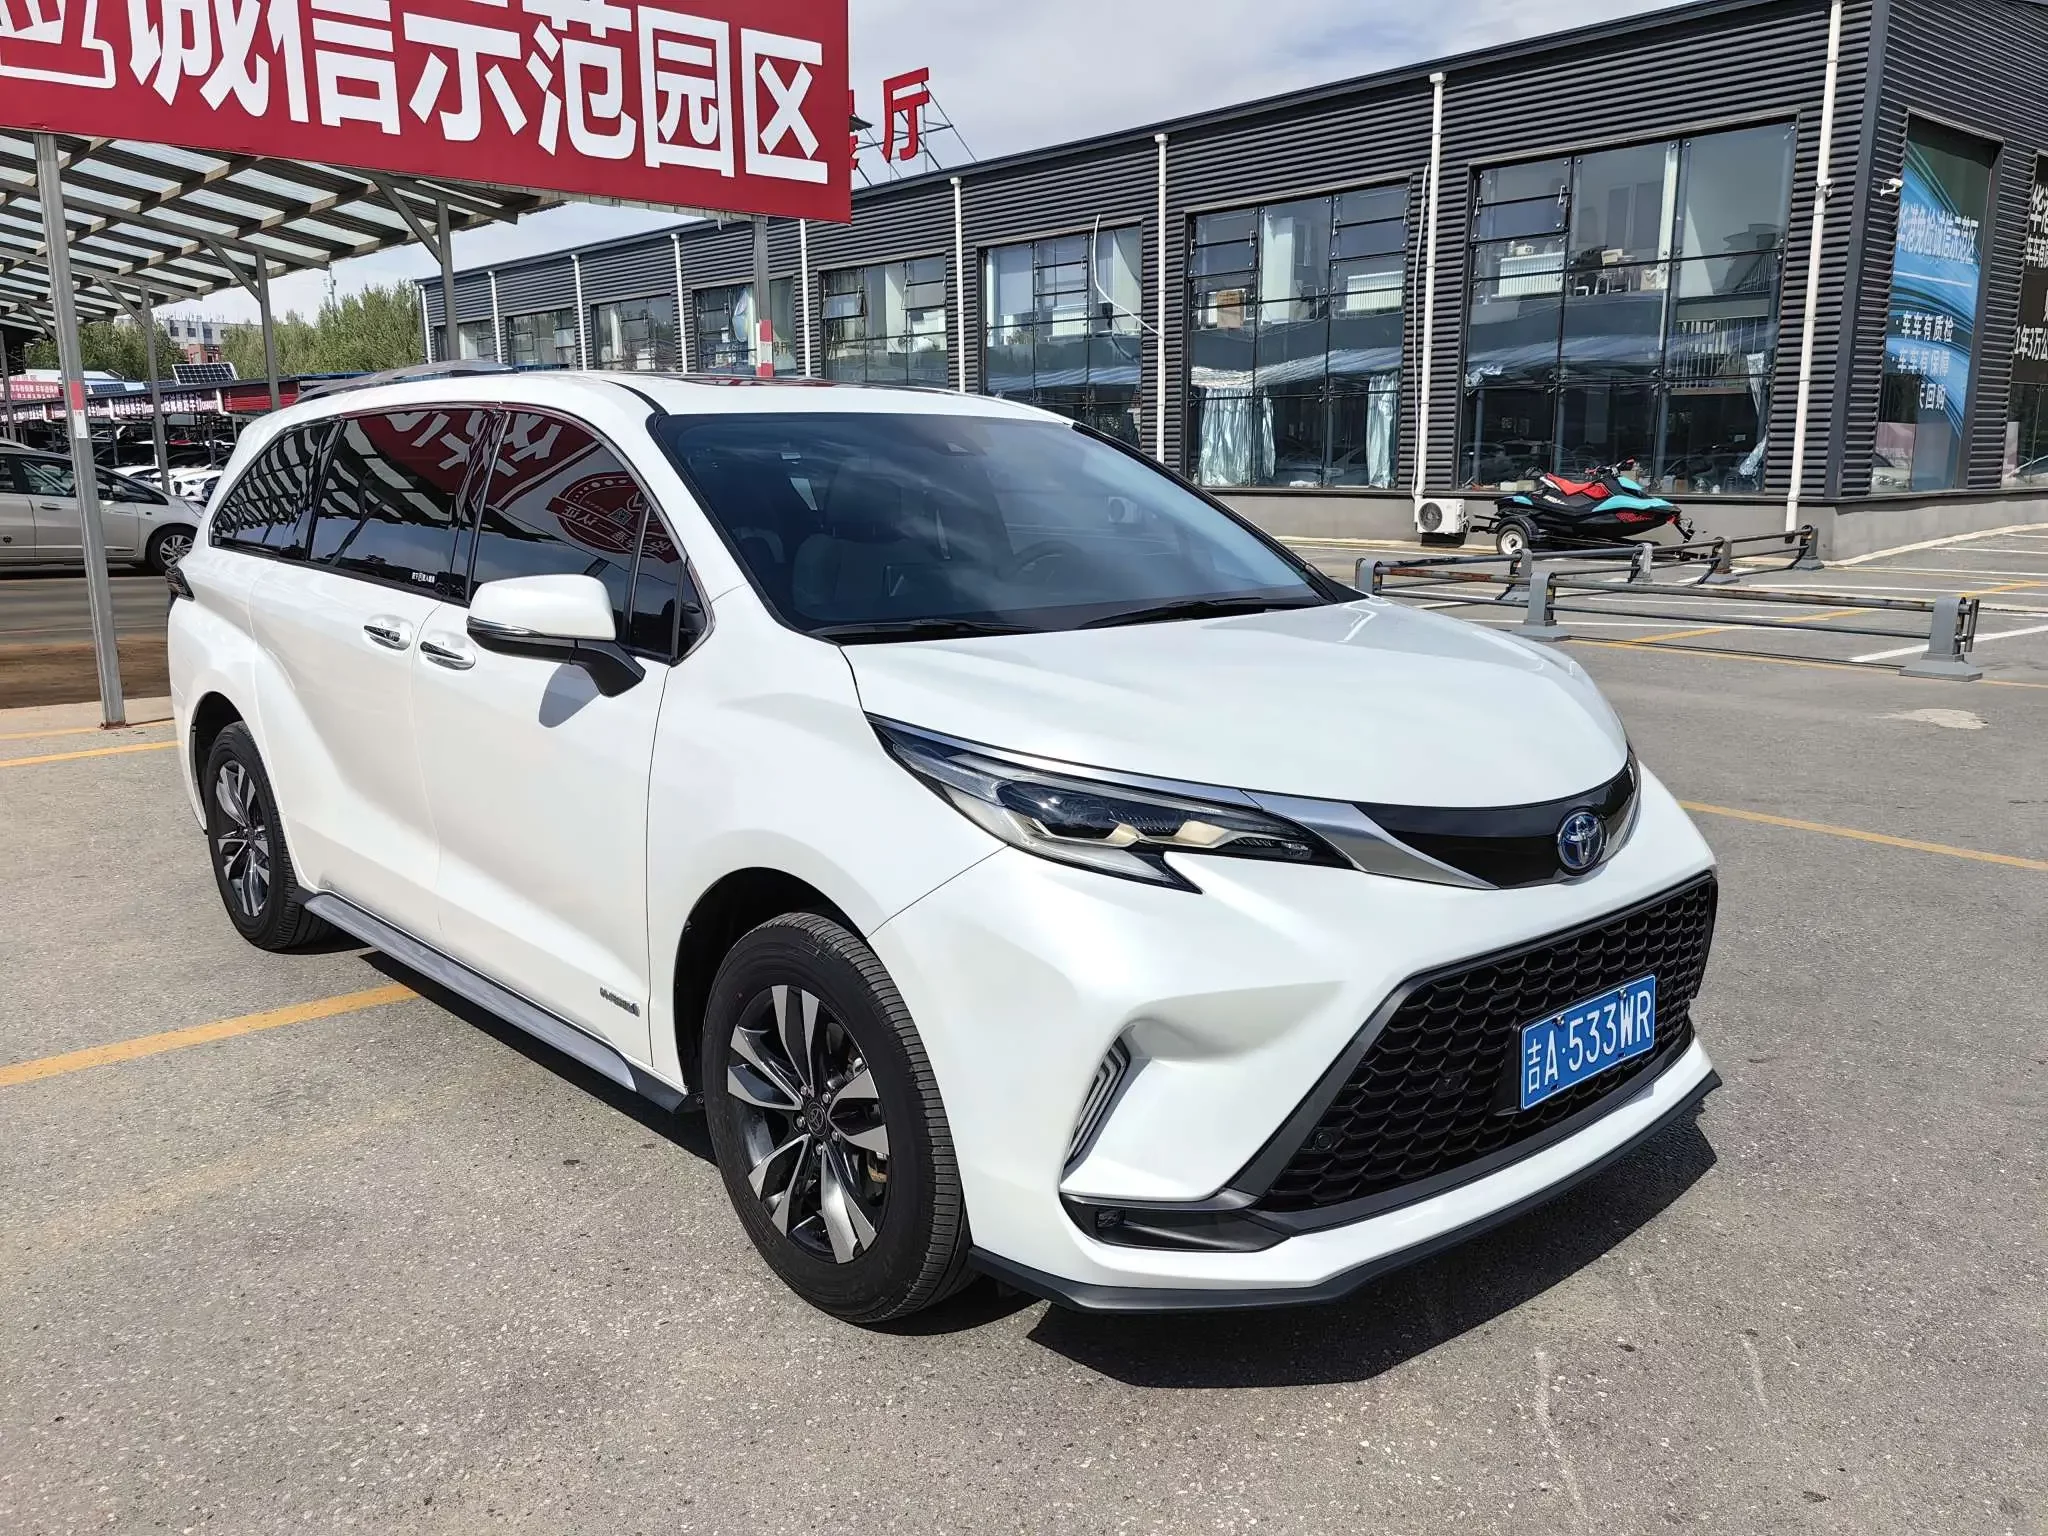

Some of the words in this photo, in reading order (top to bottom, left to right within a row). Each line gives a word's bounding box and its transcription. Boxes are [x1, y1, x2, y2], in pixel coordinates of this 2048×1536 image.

[1901, 310, 1954, 342] 车车有质检
